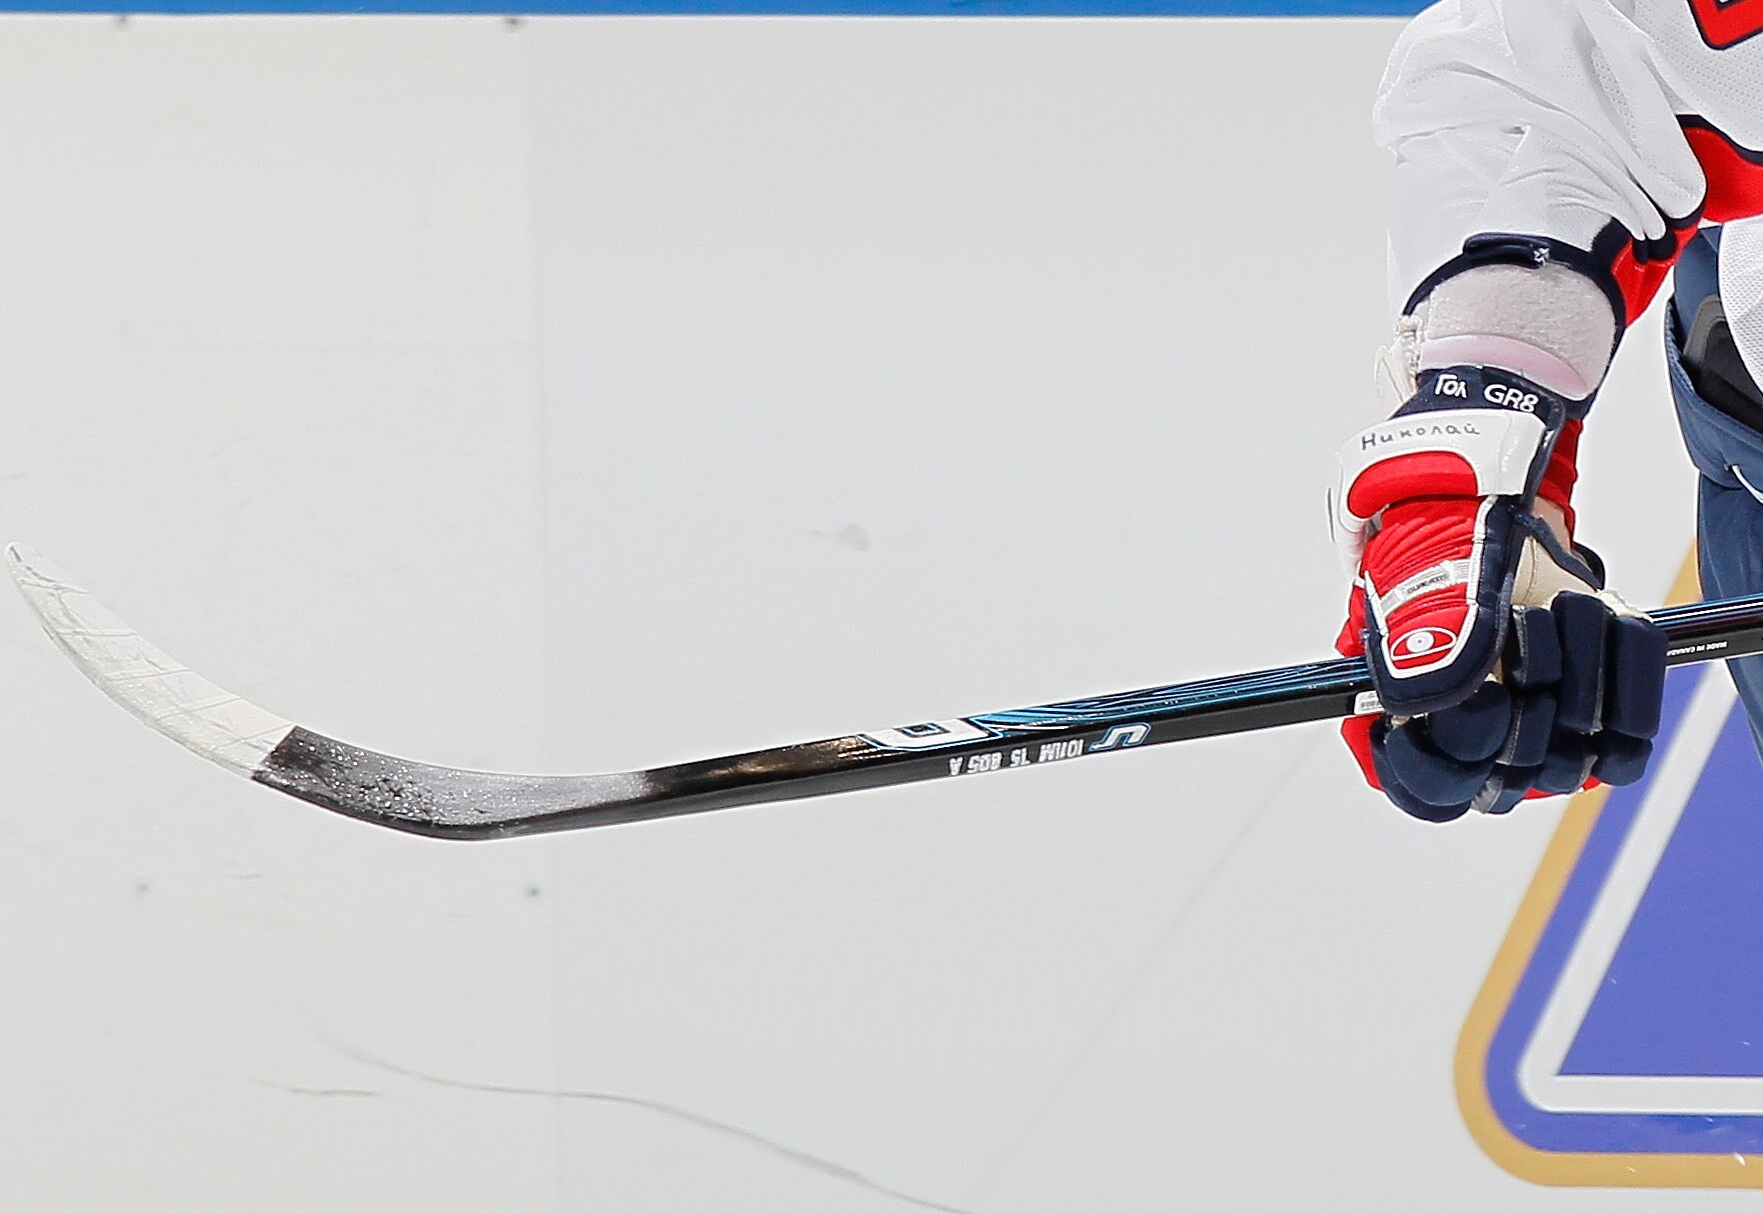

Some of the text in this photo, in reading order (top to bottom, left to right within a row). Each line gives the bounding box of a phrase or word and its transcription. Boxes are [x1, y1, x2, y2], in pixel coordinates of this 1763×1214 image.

[1482, 383, 1540, 414] GR8
[1360, 422, 1481, 451] Николай
[948, 755, 964, 777] A
